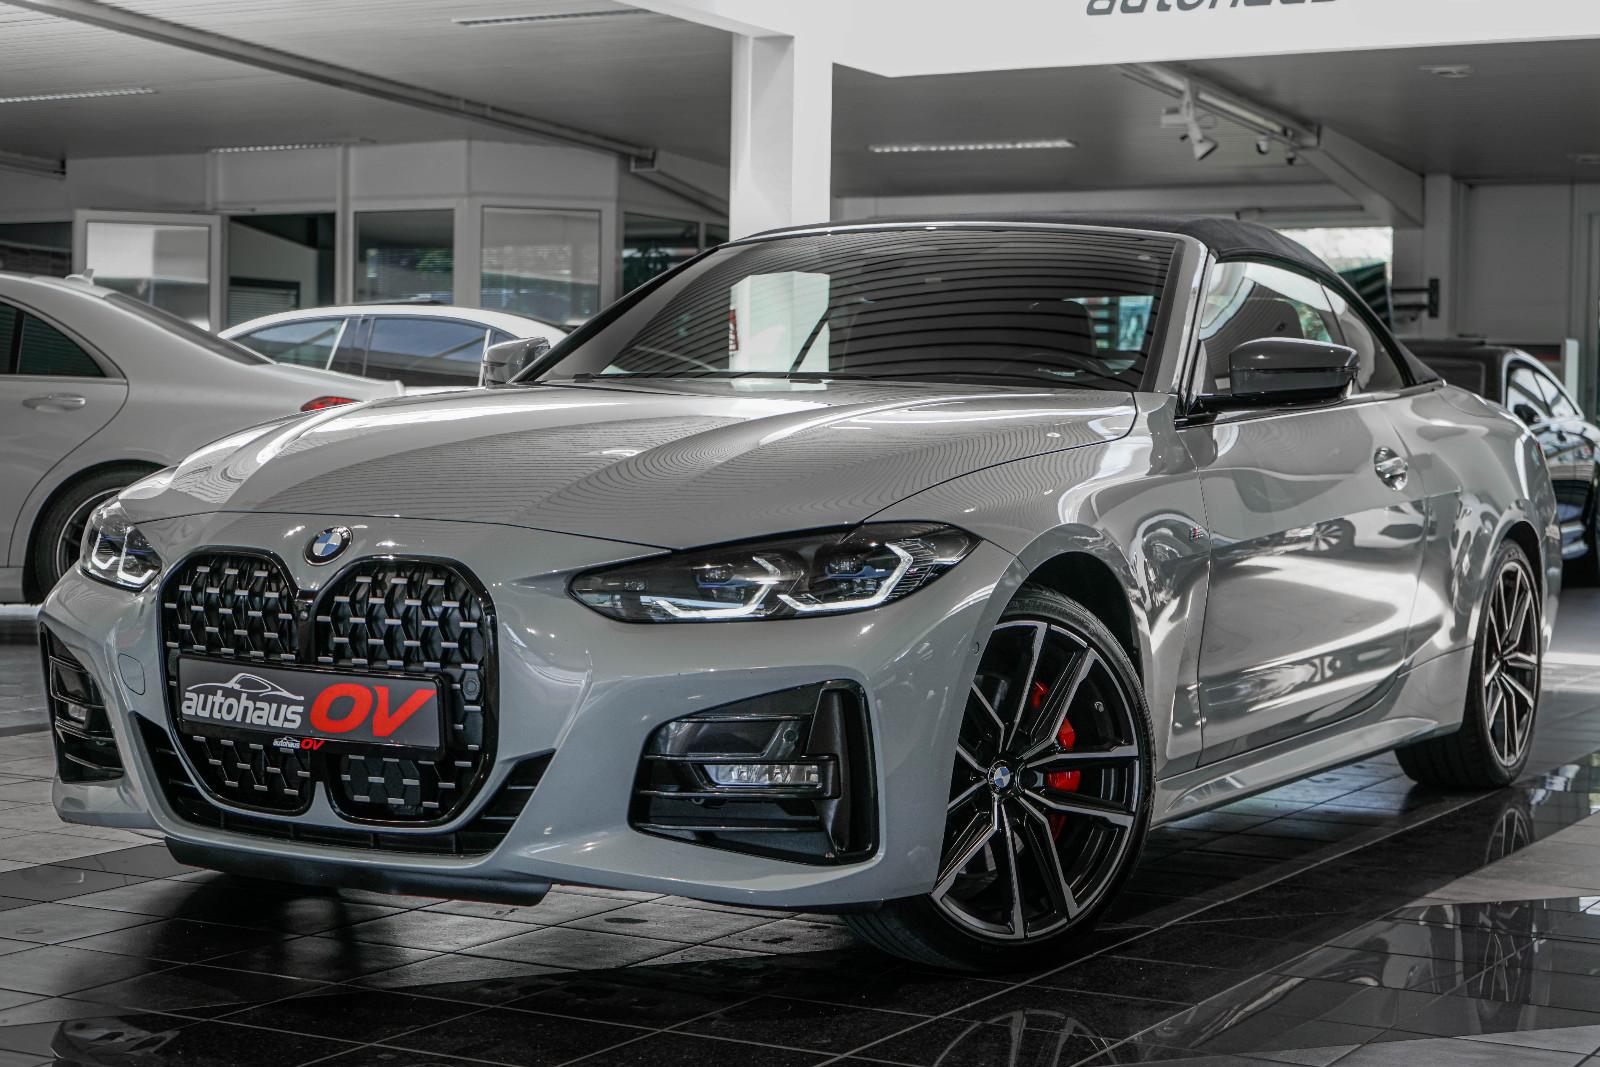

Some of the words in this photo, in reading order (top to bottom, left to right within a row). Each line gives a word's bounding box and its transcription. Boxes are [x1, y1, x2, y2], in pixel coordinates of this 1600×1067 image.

[181, 690, 304, 729] autohaus
[309, 683, 437, 737] OV
[272, 739, 300, 749] autohaus
[301, 738, 324, 750] OV
